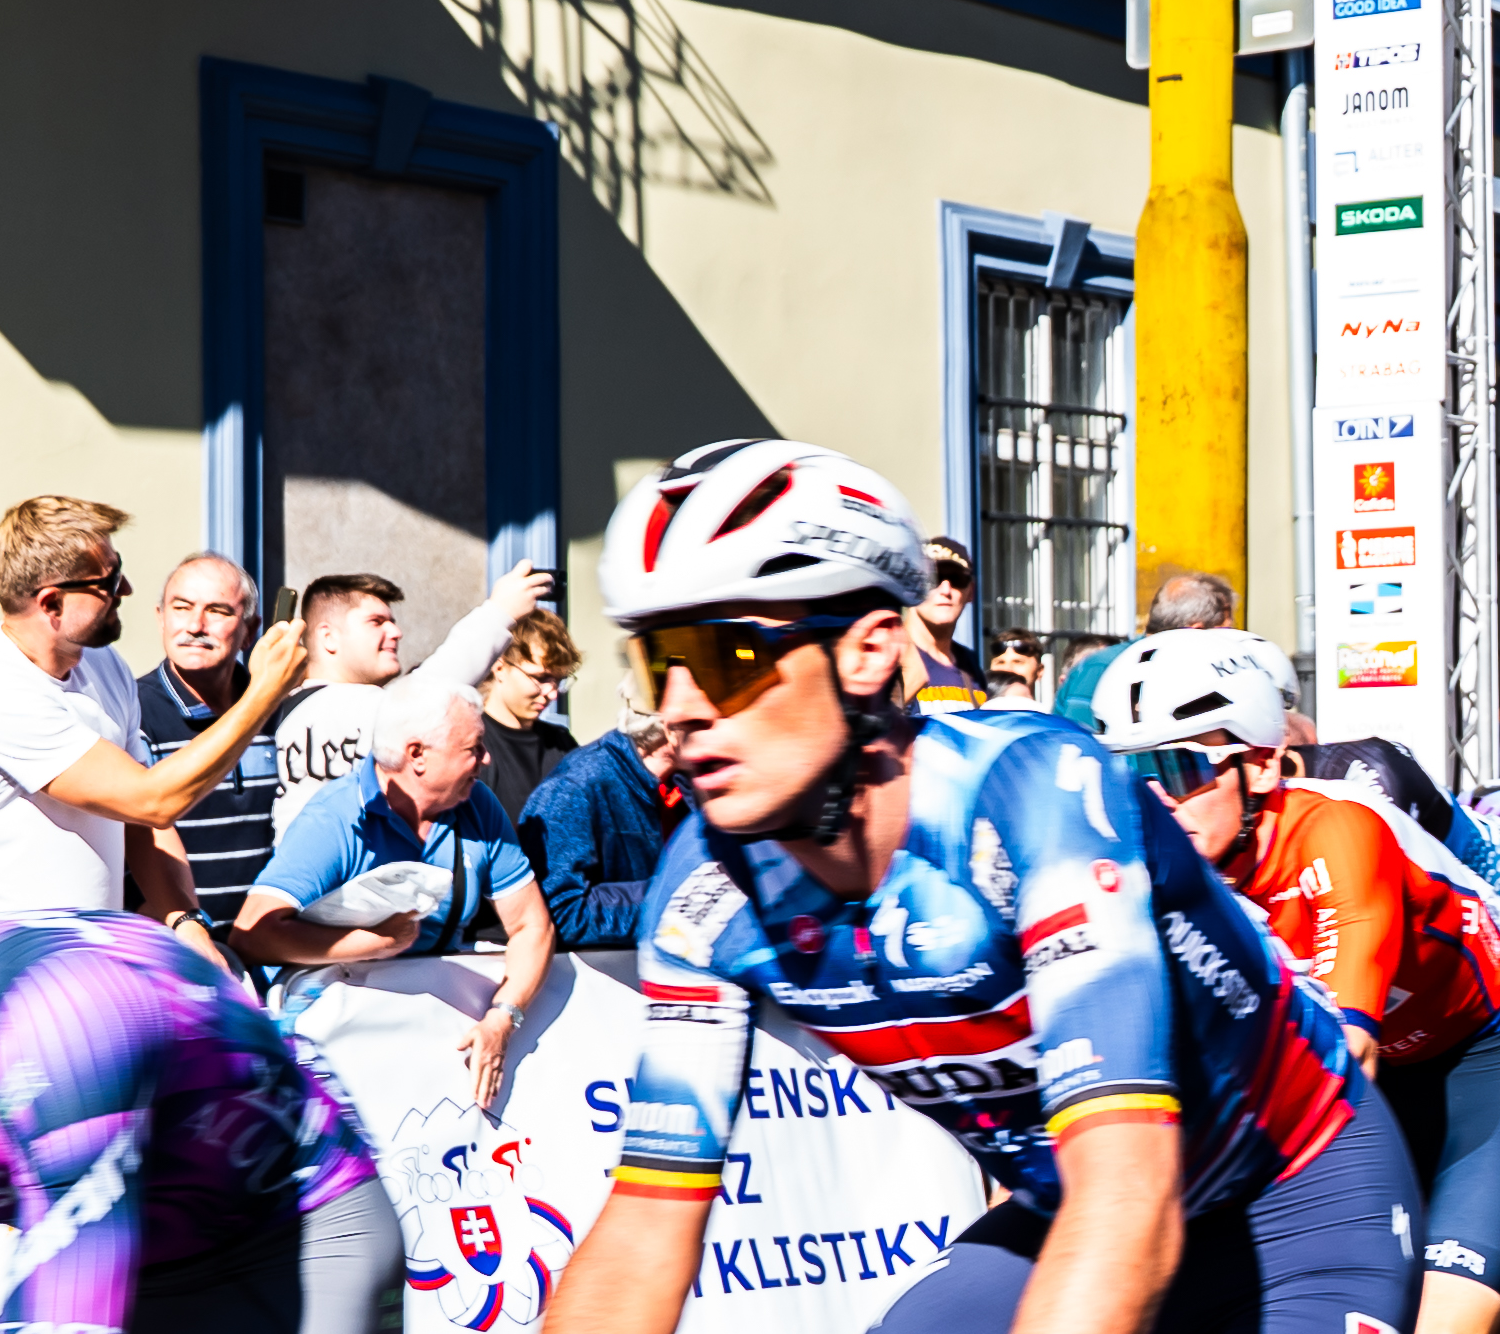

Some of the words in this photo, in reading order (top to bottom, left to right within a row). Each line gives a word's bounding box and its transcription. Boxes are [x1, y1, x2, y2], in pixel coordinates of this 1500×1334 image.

[1334, 0, 1376, 17] GOOD
[1342, 86, 1409, 116] JANOM
[1341, 318, 1421, 339] NyNa
[583, 1067, 898, 1134] SENSK
[693, 1215, 951, 1298] KLISTIKY
